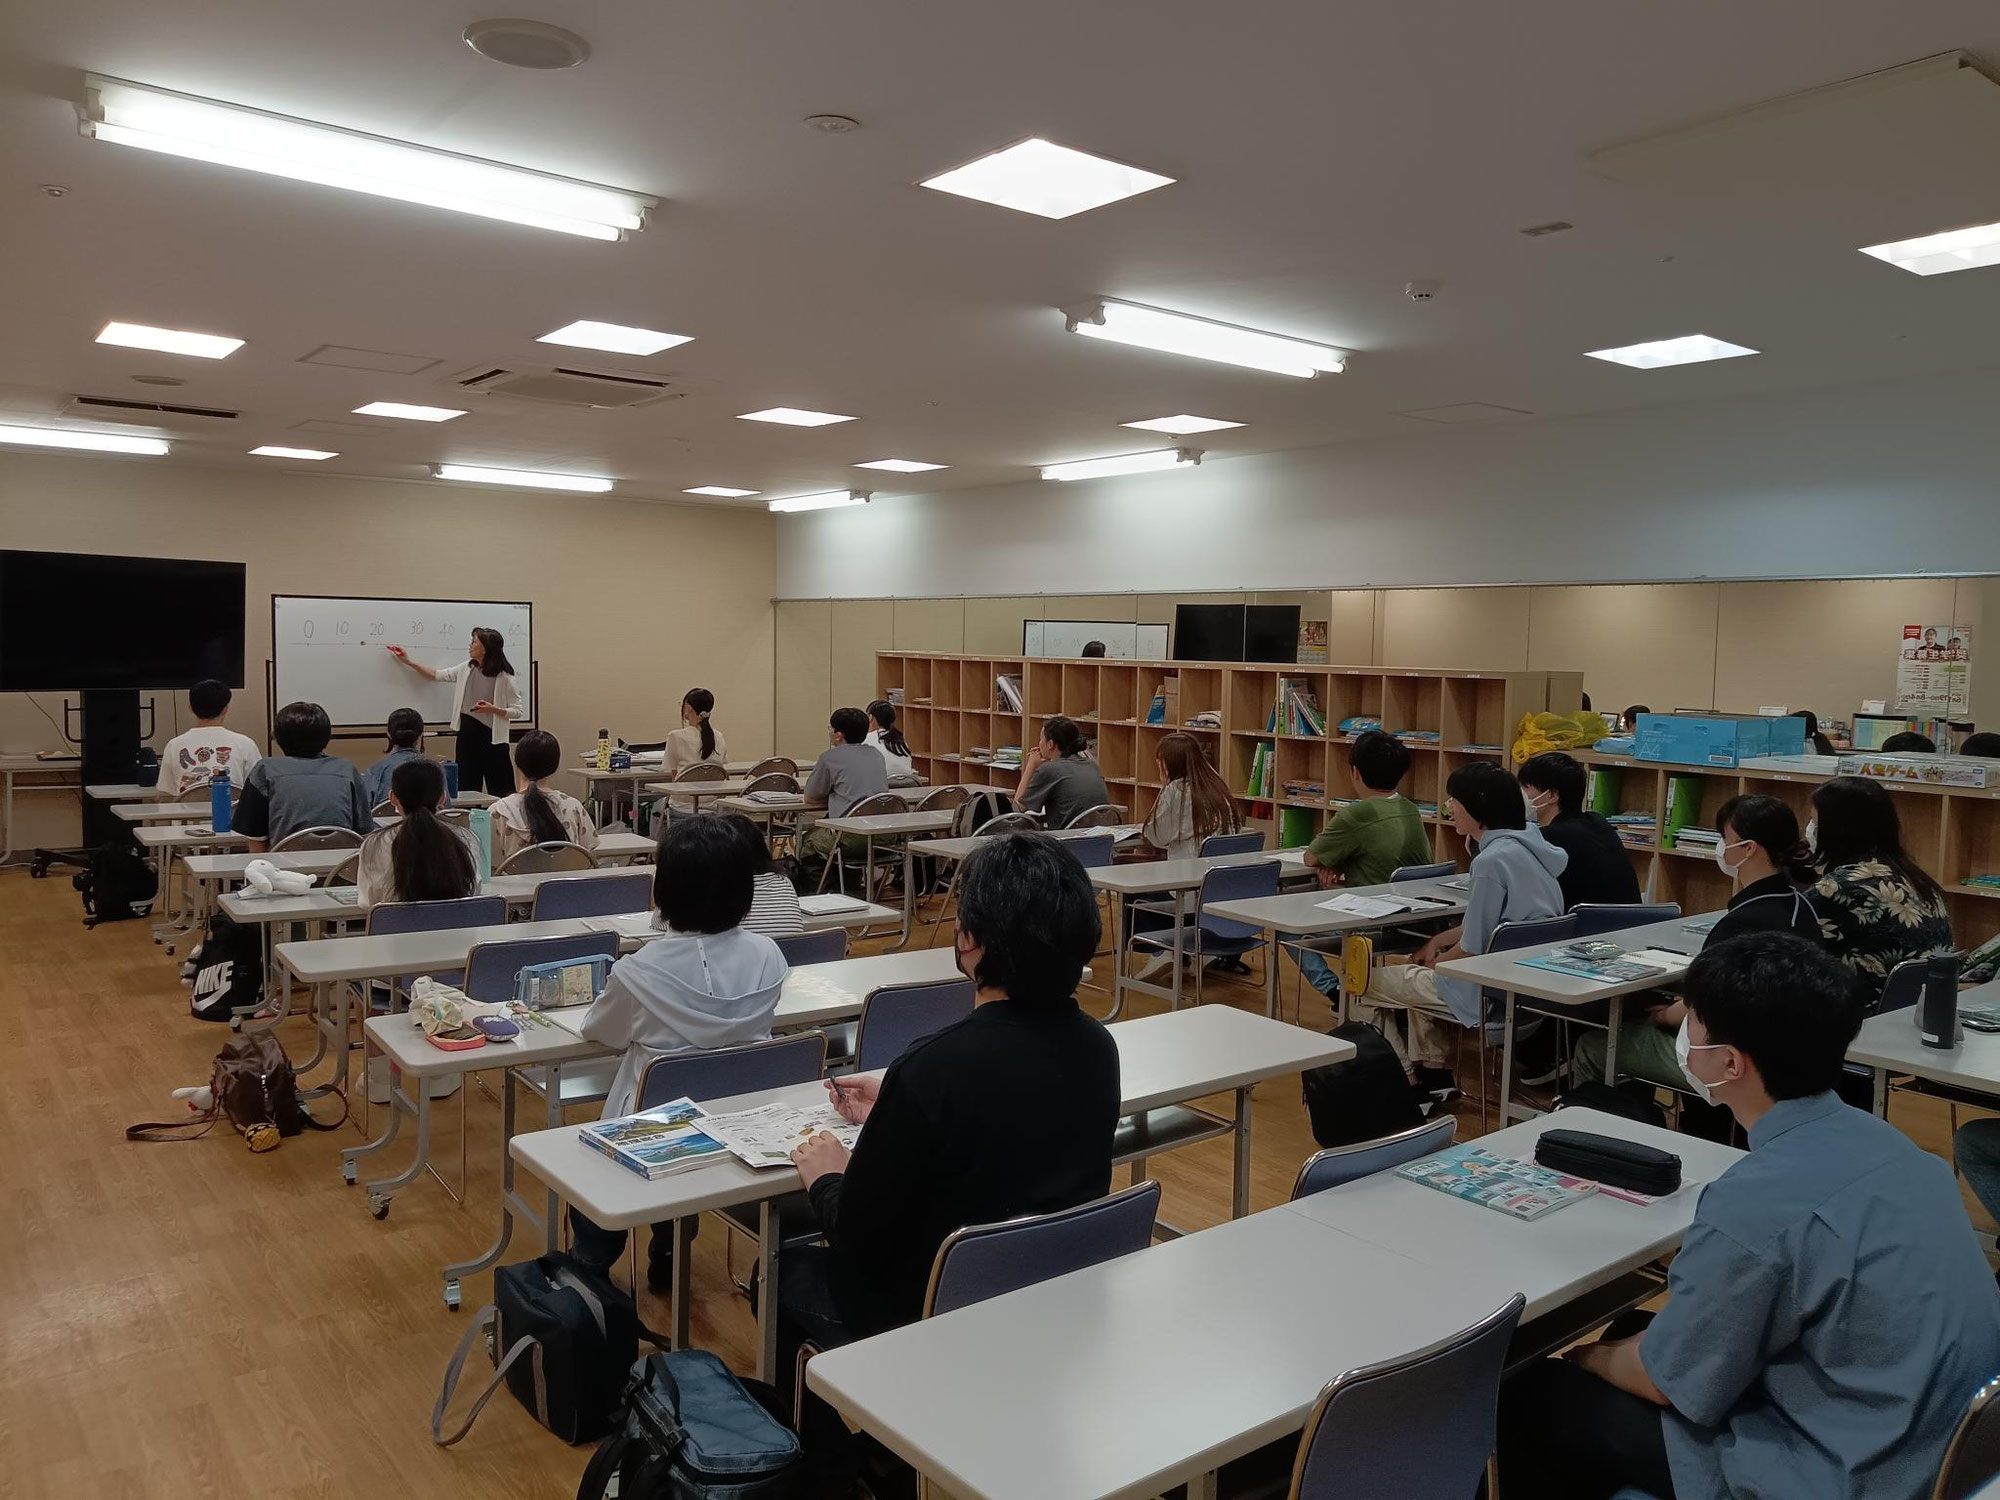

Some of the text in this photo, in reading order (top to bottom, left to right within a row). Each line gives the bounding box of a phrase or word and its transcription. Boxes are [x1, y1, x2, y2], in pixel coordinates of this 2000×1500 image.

[303, 619, 314, 639] 0
[335, 619, 350, 636] 10
[369, 623, 384, 636] 20
[408, 621, 424, 635] 30
[439, 623, 456, 638] 40
[1639, 742, 1662, 758] A4
[1859, 763, 1919, 779] 人生ゲーム
[194, 960, 234, 996] NIKE
